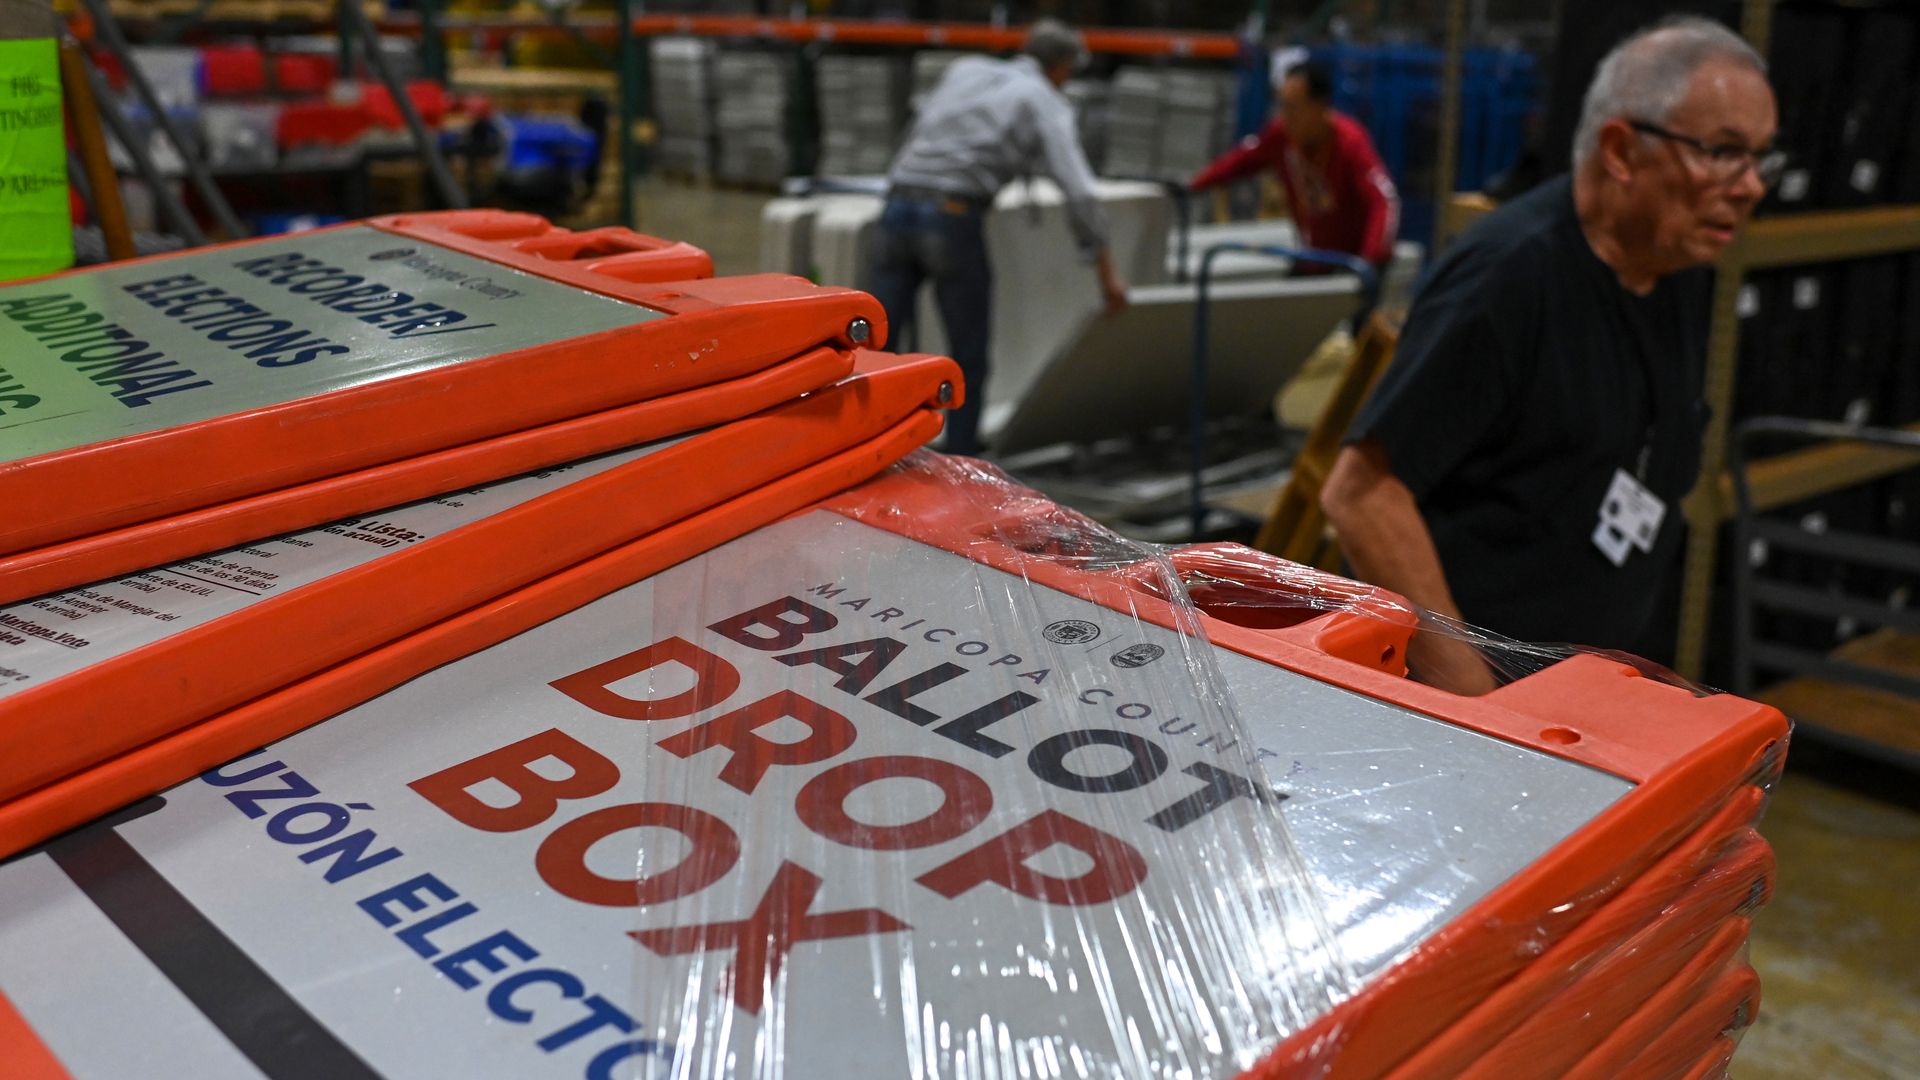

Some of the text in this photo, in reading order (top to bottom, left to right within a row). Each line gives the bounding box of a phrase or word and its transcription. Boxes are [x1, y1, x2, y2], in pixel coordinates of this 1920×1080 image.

[231, 253, 497, 340] RECORDER/
[122, 274, 350, 367] ELECTIONS
[343, 531, 400, 548] actual)
[357, 521, 425, 543] Lista:
[160, 579, 178, 587] de
[196, 566, 214, 574] de
[211, 570, 232, 579] los
[228, 574, 249, 582] 90
[237, 566, 279, 580] Cuenta
[120, 579, 162, 593] arriba)
[32, 600, 89, 621] de arriba)
[60, 597, 109, 613] Anterior
[96, 595, 114, 603] de
[110, 599, 160, 616] Manejar
[154, 612, 182, 622] del
[807, 582, 1051, 685] MARICOPA
[706, 595, 1290, 833] BALLOT
[547, 635, 1148, 905] DROP
[405, 727, 914, 1016] BOX
